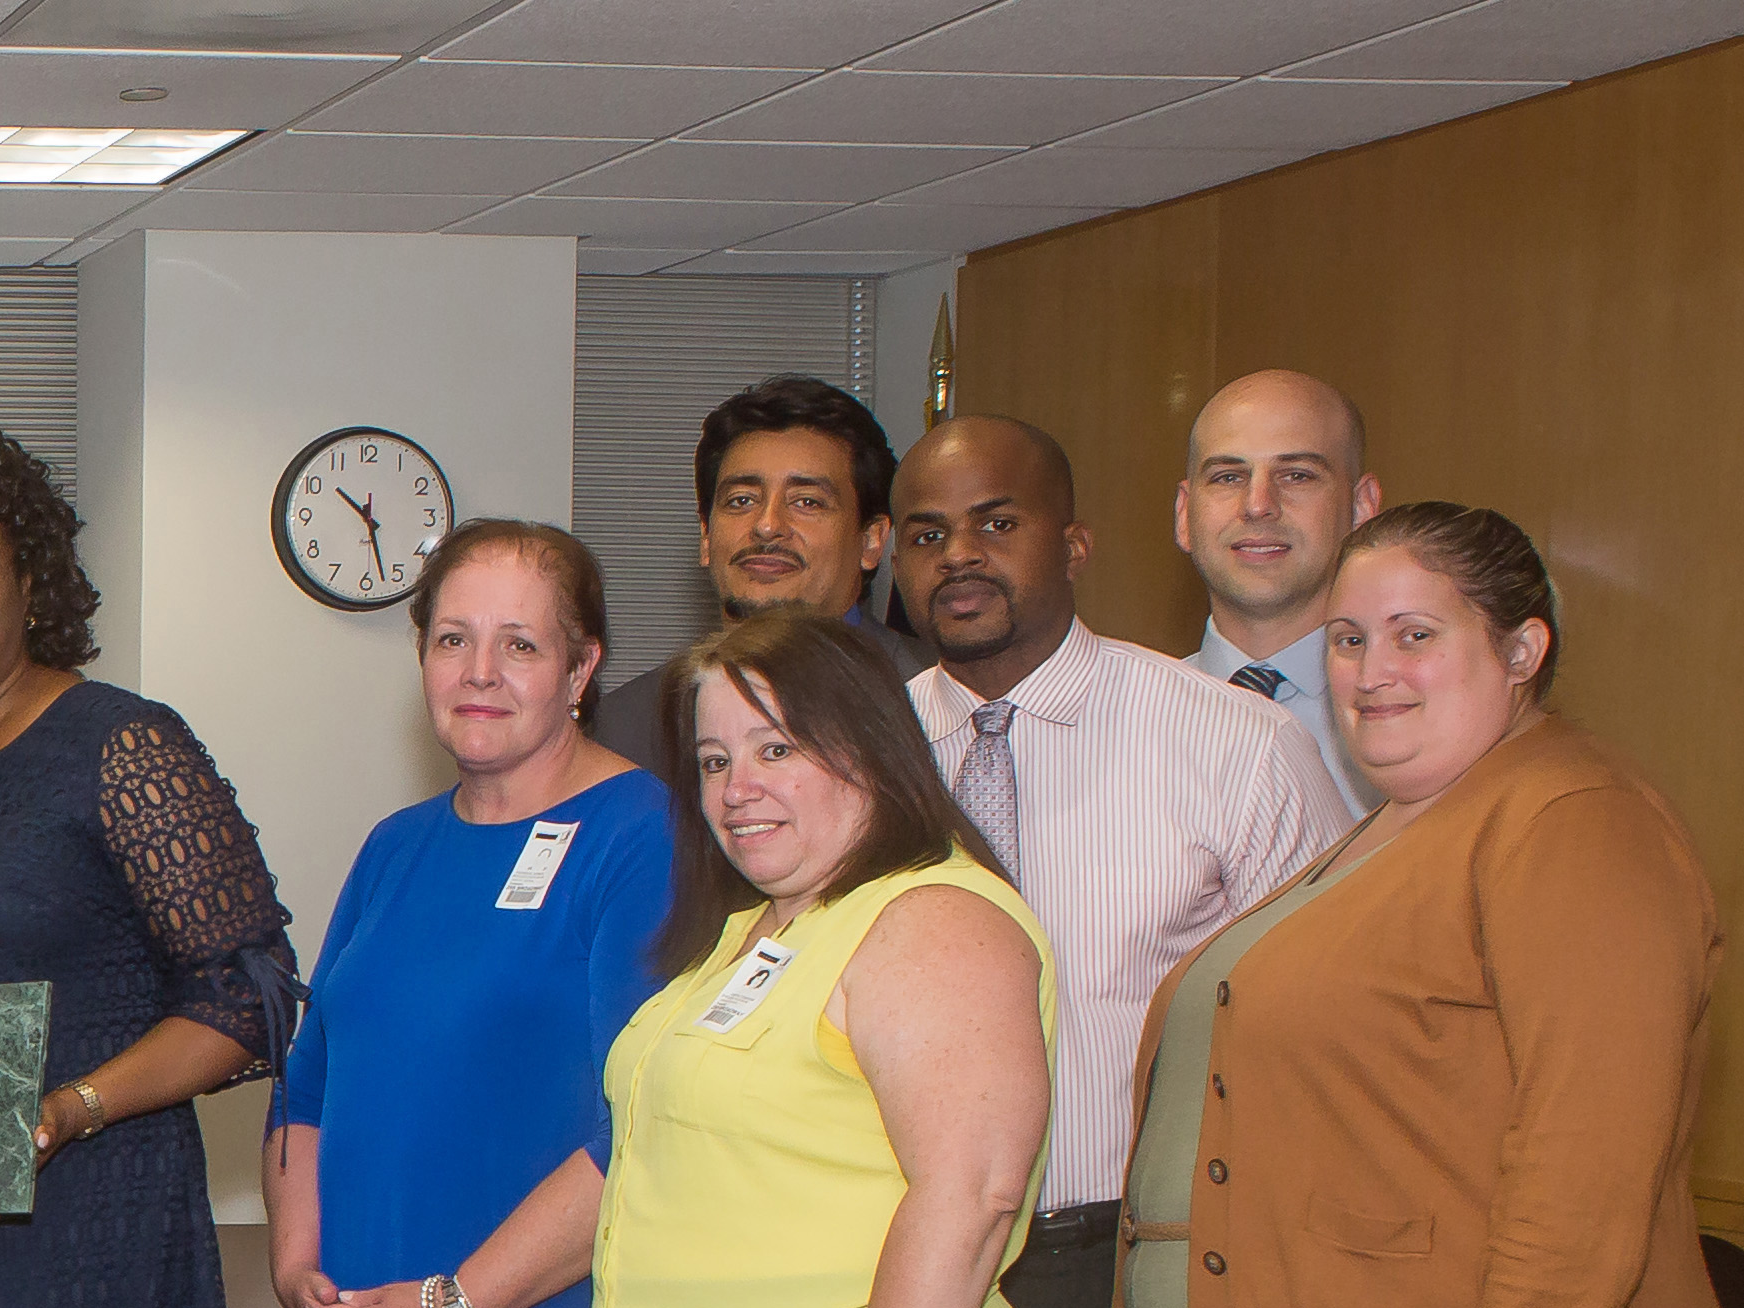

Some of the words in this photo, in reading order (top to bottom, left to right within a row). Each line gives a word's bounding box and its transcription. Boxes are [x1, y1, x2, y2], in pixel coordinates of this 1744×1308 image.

[331, 452, 345, 471] 11
[360, 444, 378, 463] 12
[305, 475, 322, 494] 10
[414, 476, 428, 496] 2
[298, 507, 313, 526] 9
[423, 508, 436, 527] 3
[306, 539, 320, 559] 8
[412, 541, 428, 560] 4
[328, 563, 342, 582] 7
[359, 571, 373, 591] 6
[391, 564, 405, 582] 5
